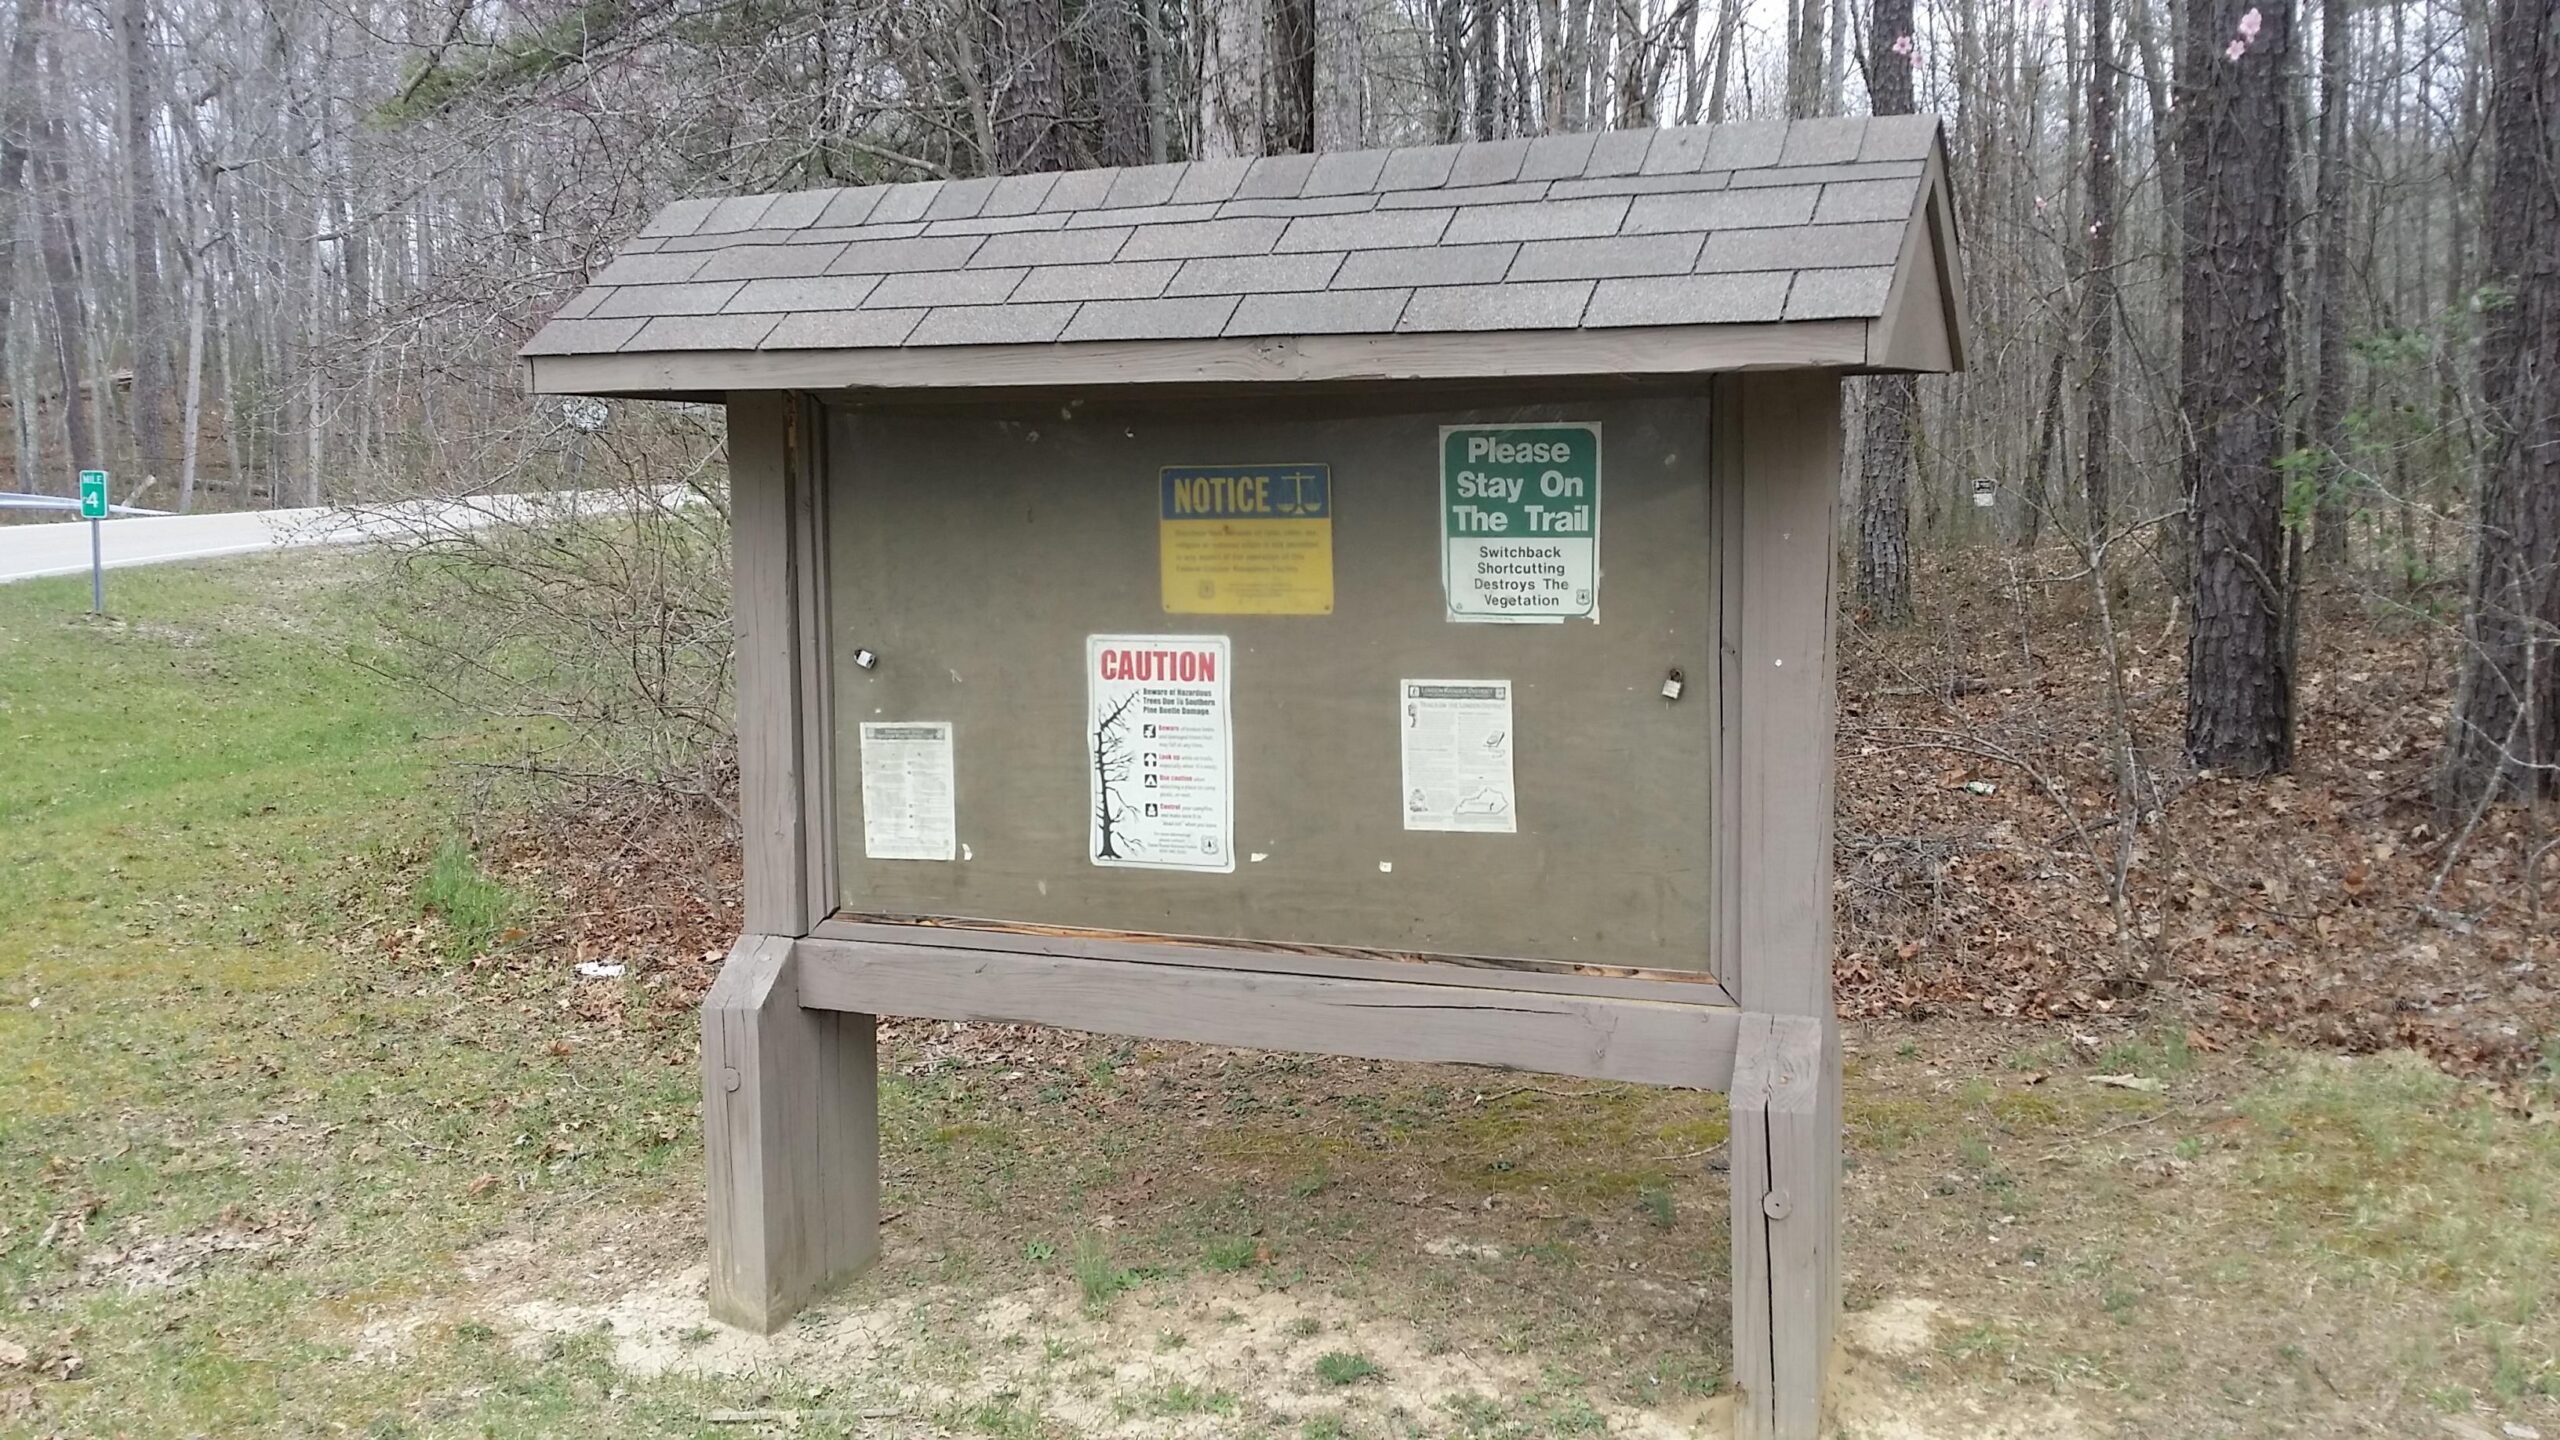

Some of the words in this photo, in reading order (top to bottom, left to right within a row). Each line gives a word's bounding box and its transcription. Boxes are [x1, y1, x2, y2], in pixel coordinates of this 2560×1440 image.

[1468, 437, 1570, 464] Please
[83, 475, 103, 484] MILE
[1457, 470, 1524, 503] Stay
[1540, 470, 1584, 498] On
[86, 491, 99, 508] 4
[1174, 476, 1272, 514] NOTICE
[1452, 505, 1508, 532] The
[1524, 505, 1589, 532] Trail
[1479, 546, 1561, 559] Switchback
[1477, 562, 1566, 576] Shortcutting
[1474, 578, 1536, 592] Destroys
[1543, 578, 1569, 591] The
[1484, 594, 1560, 608] Vegetation
[1101, 650, 1215, 682] CAUTION
[1143, 688, 1168, 696] Beware
[1177, 688, 1212, 697] Hazardous
[1143, 696, 1161, 705] Trees
[1185, 698, 1216, 706] Southern
[1143, 706, 1157, 714] Pine
